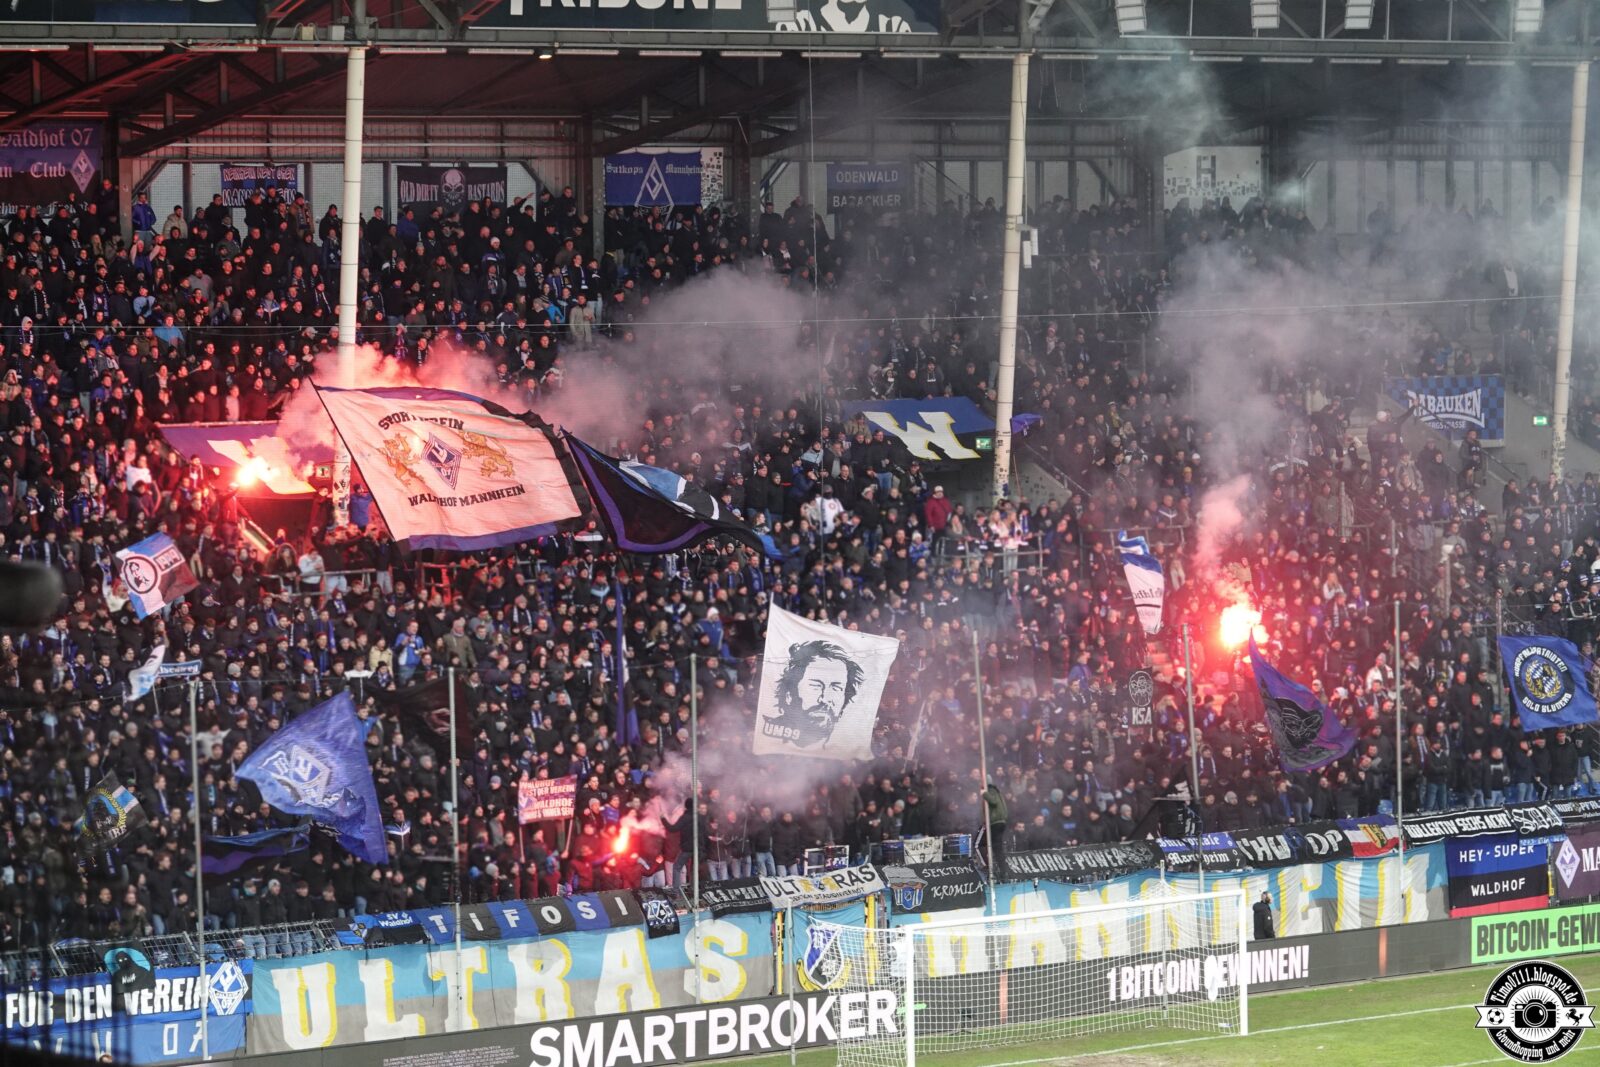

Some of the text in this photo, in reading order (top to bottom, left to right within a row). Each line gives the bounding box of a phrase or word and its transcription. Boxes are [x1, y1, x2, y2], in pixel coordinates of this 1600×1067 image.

[30, 161, 66, 178] Club
[835, 170, 899, 184] ODENWALD
[401, 180, 439, 203] OLD DIRTY
[468, 181, 505, 203] BASTARDS
[378, 411, 464, 431] SPOREIN
[764, 722, 800, 740] UM99
[1403, 809, 1515, 838] KOLLEKTIV SECHS ACHT!
[1168, 851, 1230, 866] Manheim
[1459, 848, 1483, 864] HEY
[1494, 843, 1534, 859] SUPER
[922, 864, 974, 878] SEKTION
[1470, 877, 1526, 896] WALDHOF
[429, 896, 628, 933] TIFOSI
[271, 918, 748, 1050] ULTRAS
[1106, 966, 1117, 1001] 1
[1120, 958, 1200, 1001] BITCOIN
[6, 974, 211, 1028] FÜR DEN VEREIN
[528, 989, 900, 1067] SMARTBROKER
